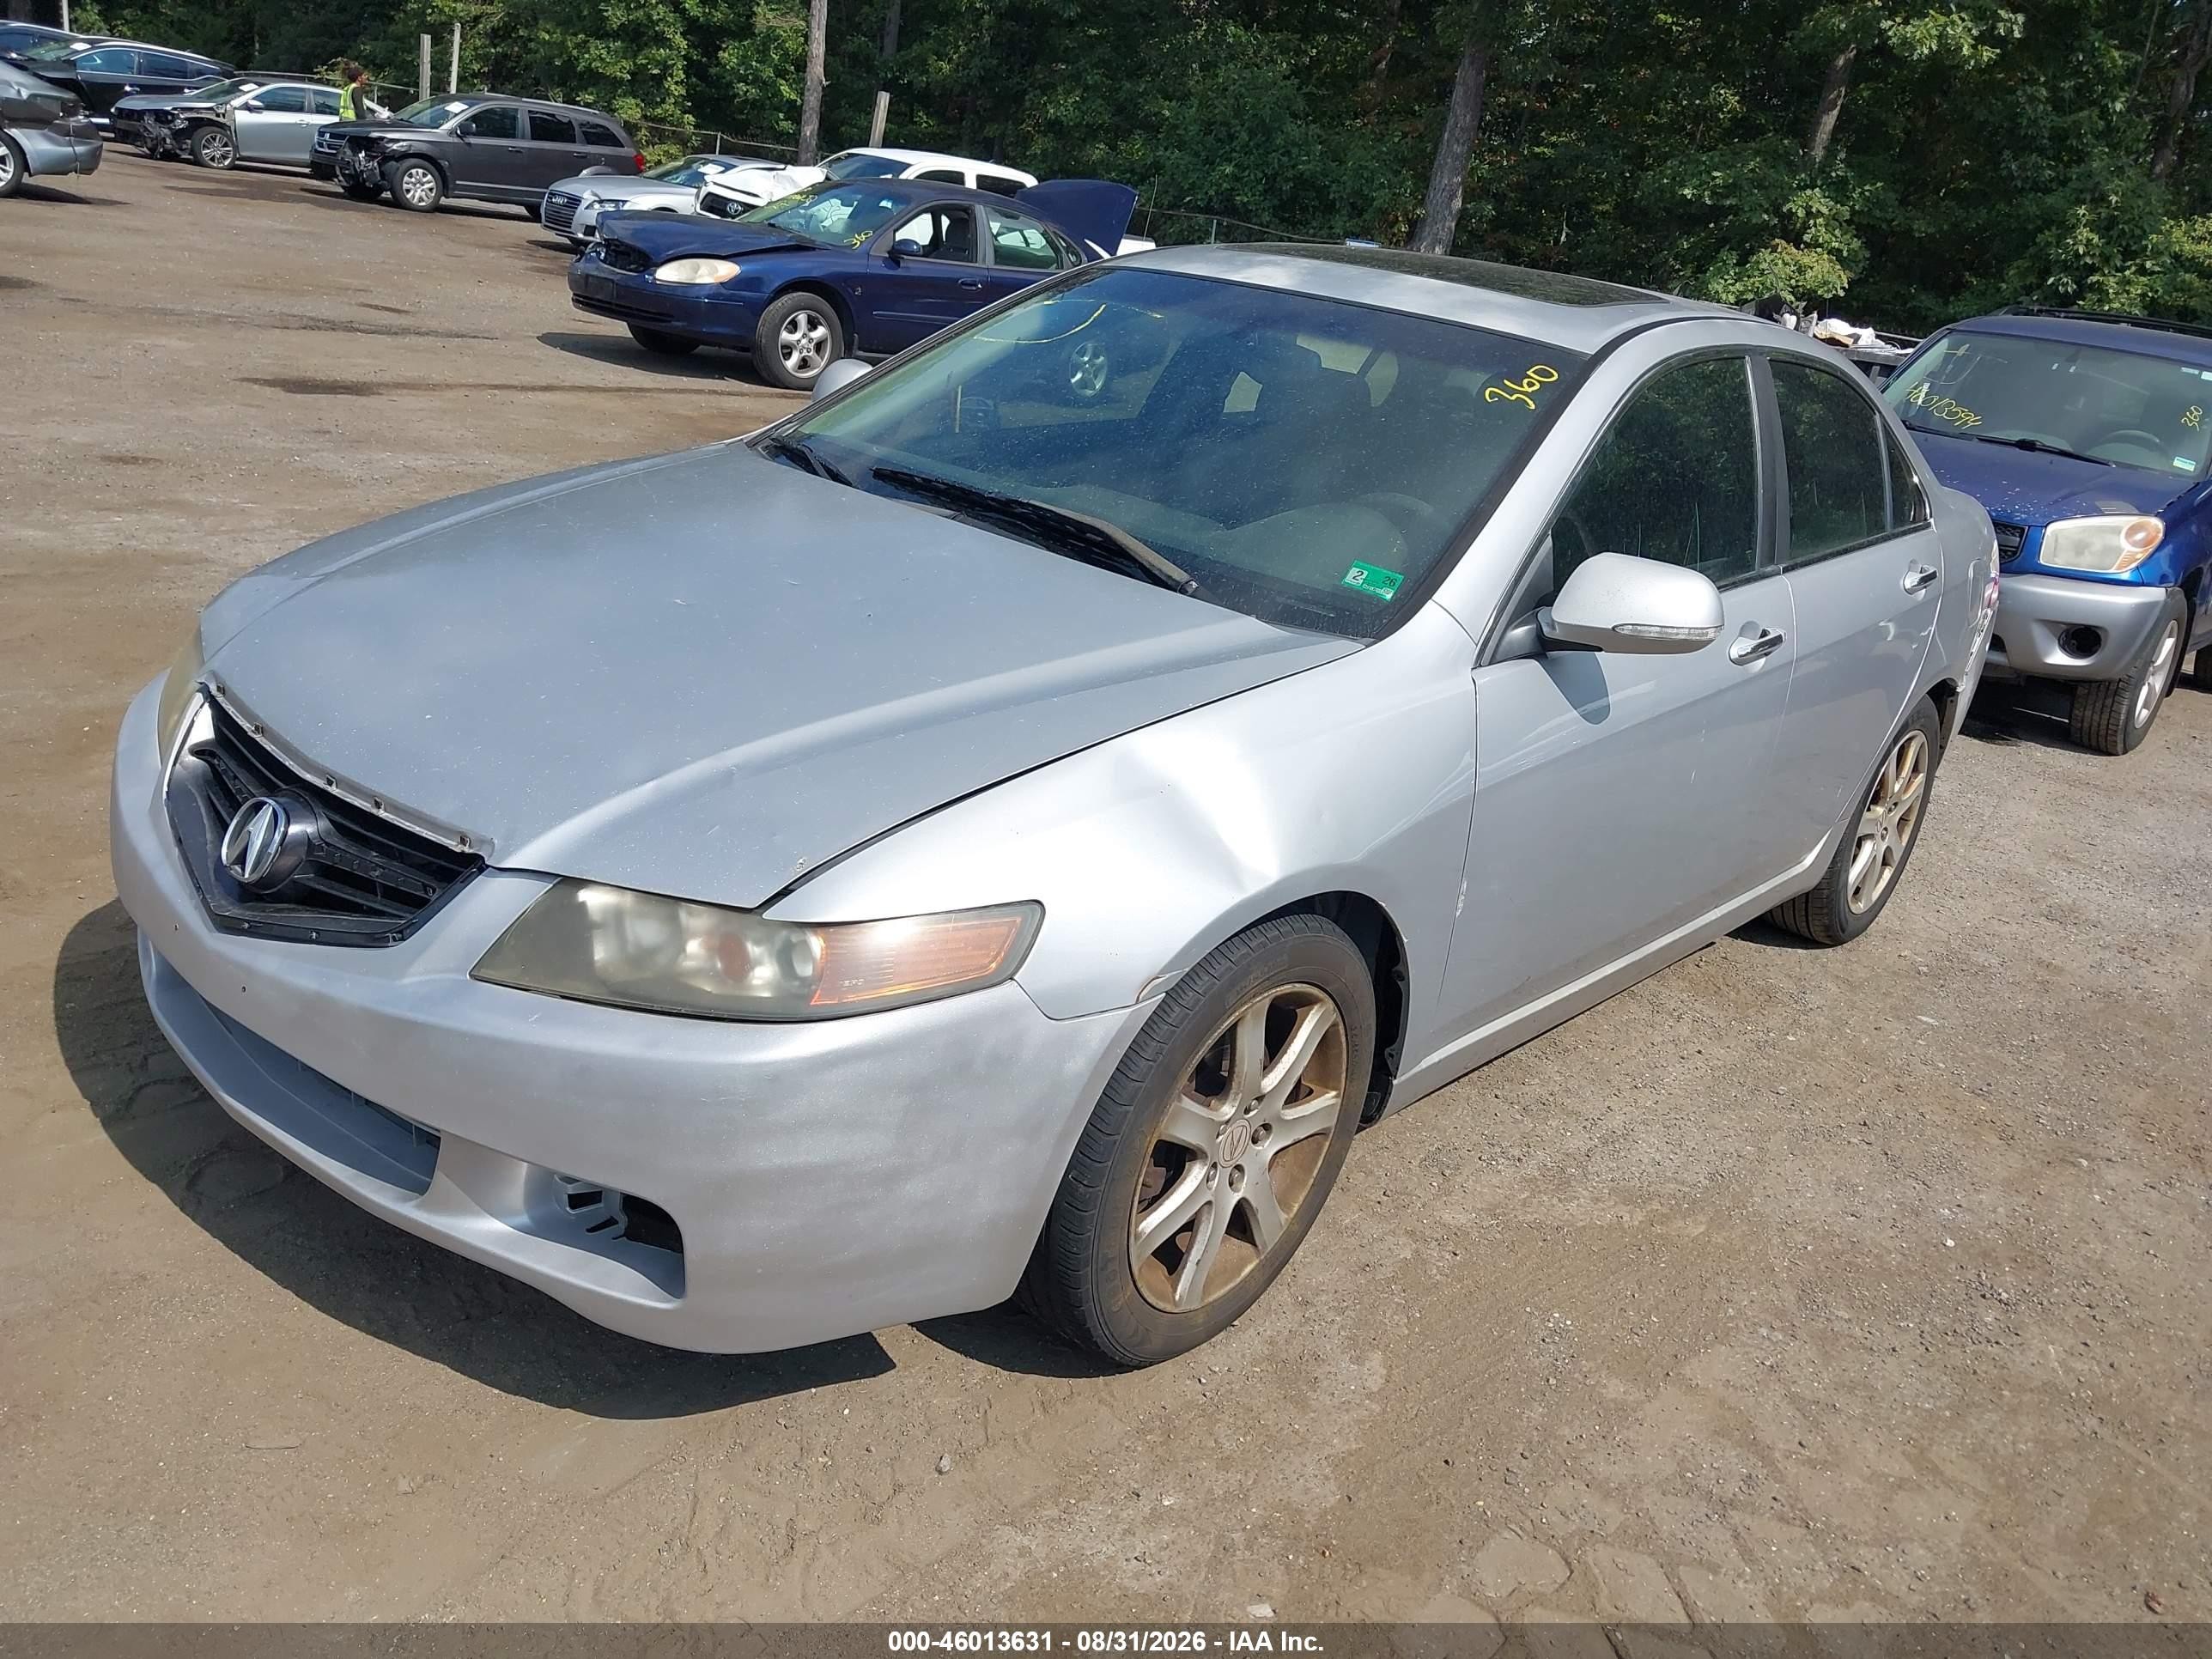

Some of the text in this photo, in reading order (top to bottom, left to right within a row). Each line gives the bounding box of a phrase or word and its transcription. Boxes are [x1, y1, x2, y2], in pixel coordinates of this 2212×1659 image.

[1485, 365, 1559, 409] 360
[2181, 405, 2203, 432] 360
[1352, 570, 1398, 587] 2 26
